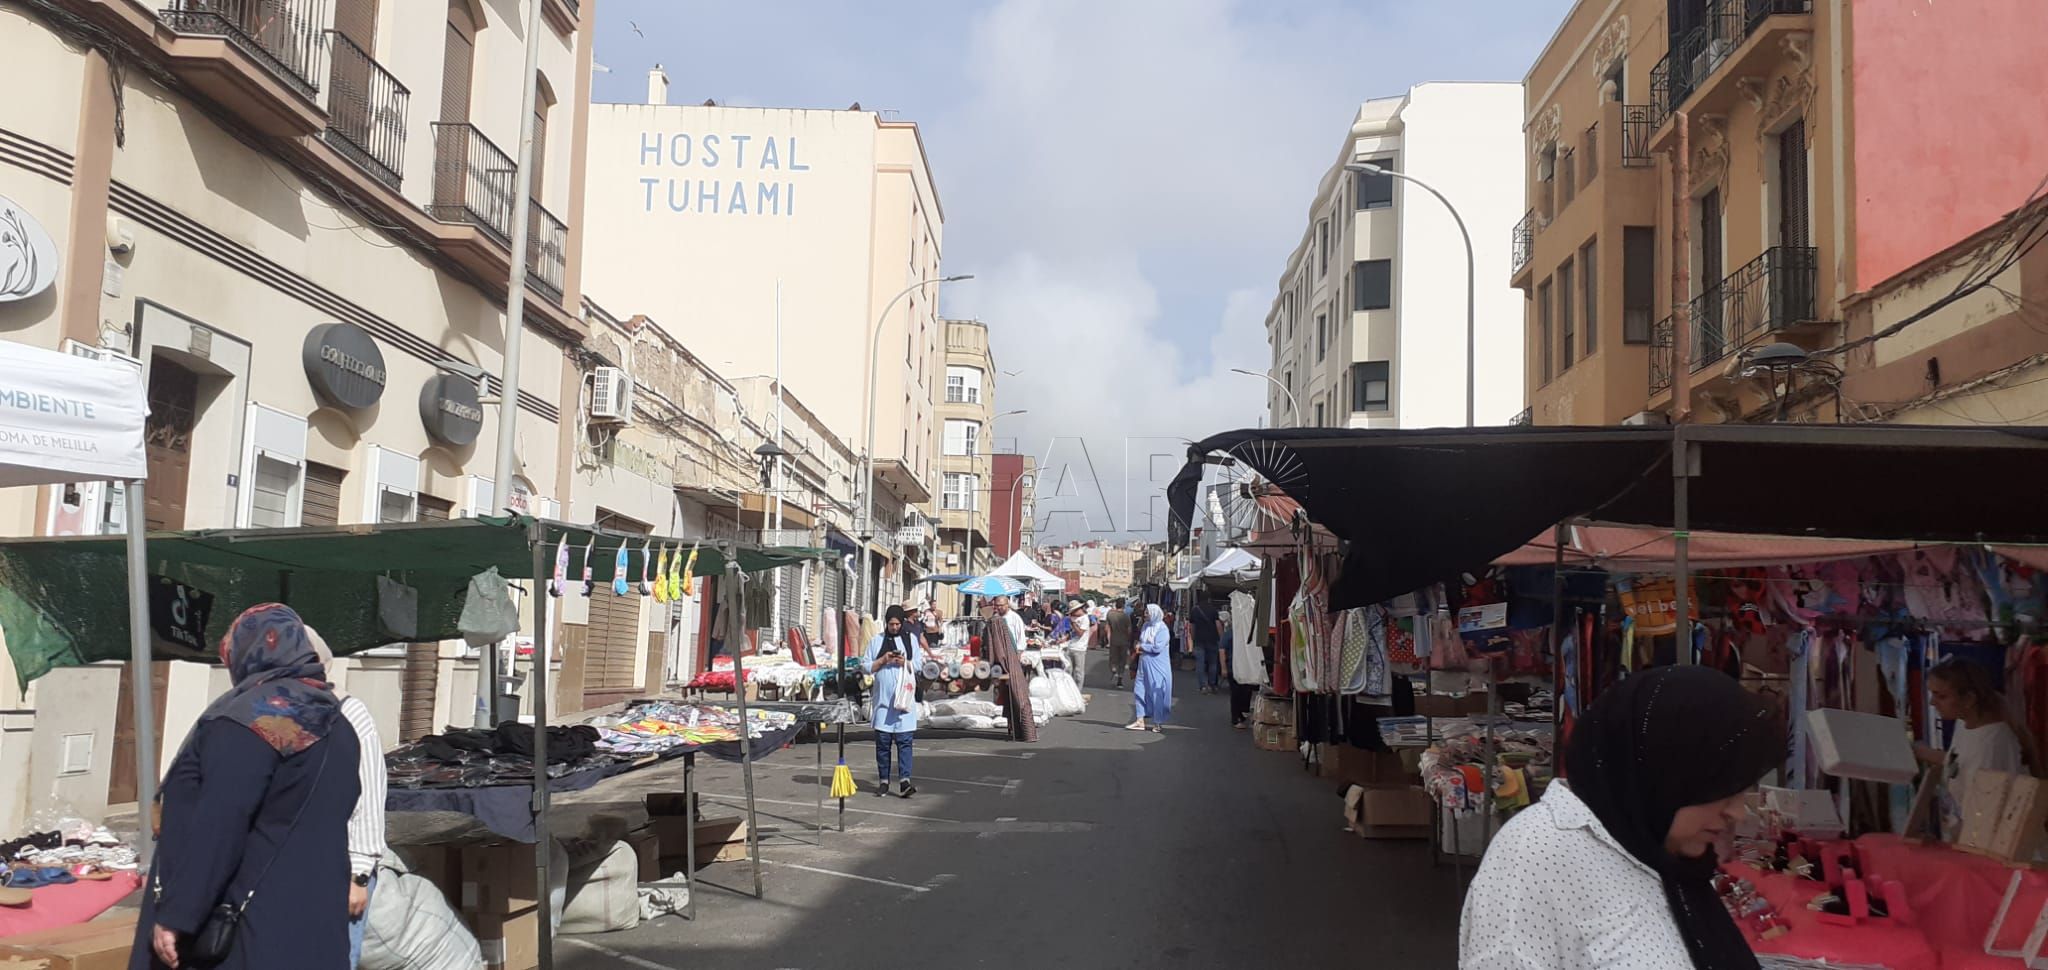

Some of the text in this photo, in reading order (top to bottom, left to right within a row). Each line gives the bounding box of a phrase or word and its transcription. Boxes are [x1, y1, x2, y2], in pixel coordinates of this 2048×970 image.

[640, 132, 810, 171] HOSTAL
[639, 178, 794, 216] TUHAMI
[32, 433, 50, 447] DE
[51, 438, 98, 453] MELILLA
